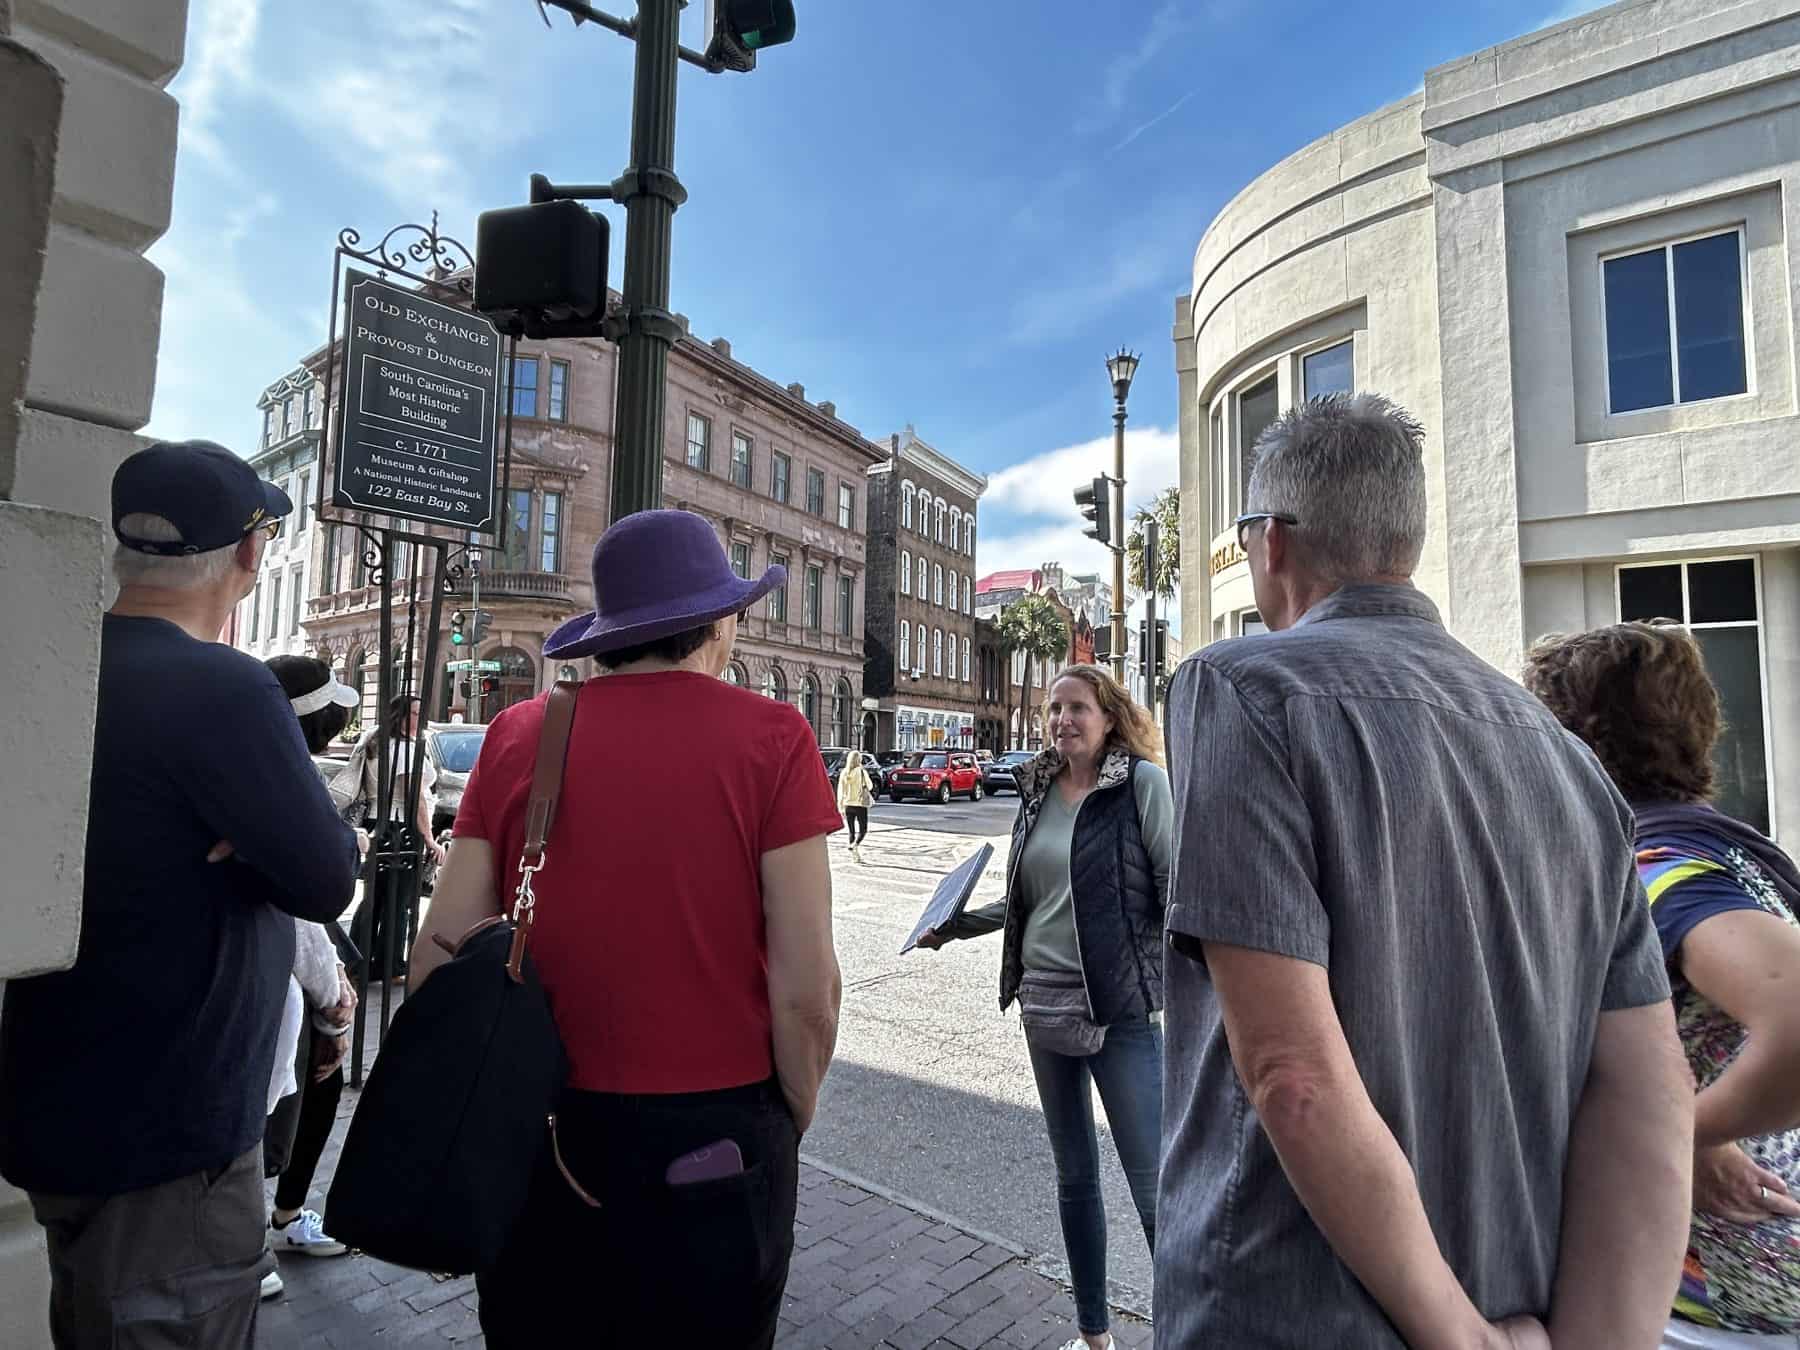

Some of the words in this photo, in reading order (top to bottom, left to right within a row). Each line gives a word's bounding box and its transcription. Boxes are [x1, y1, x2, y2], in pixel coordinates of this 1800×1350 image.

[425, 332, 437, 344] &
[380, 366, 413, 385] South
[417, 376, 469, 400] Carolina's
[388, 386, 416, 402] Most
[419, 395, 461, 414] Historic
[401, 406, 447, 429] Building
[414, 441, 447, 459] 1771
[353, 466, 361, 475] A
[363, 468, 401, 483] National
[404, 475, 438, 490] Historic
[440, 484, 482, 500] Landmark
[371, 454, 414, 471] Museum
[417, 464, 426, 473] &
[428, 467, 468, 484] Giftshop
[367, 484, 392, 497] 122
[395, 489, 424, 504] East
[427, 495, 452, 512] Bay
[455, 501, 470, 513] St.
